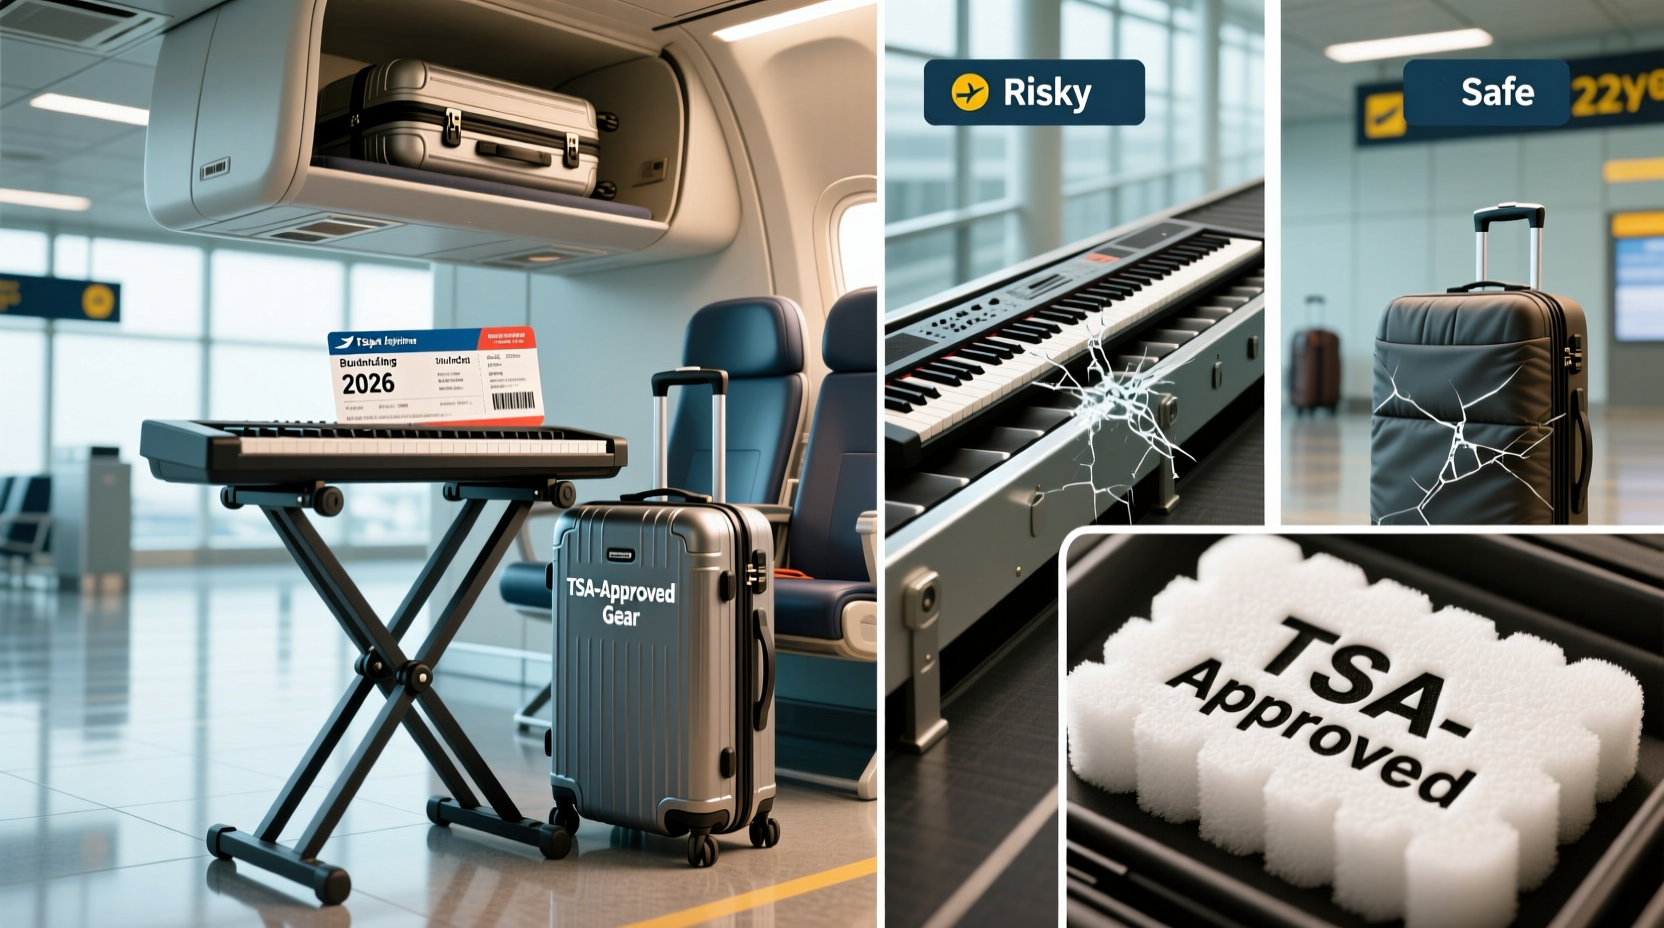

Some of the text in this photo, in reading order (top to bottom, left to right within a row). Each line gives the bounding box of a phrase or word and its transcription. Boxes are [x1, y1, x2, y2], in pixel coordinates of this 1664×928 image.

[341, 372, 395, 395] 2026
[566, 577, 676, 605] TSA-Approved
[602, 605, 641, 627] Gear
[1263, 615, 1472, 739] TSA-
[1164, 658, 1477, 809] Approved
